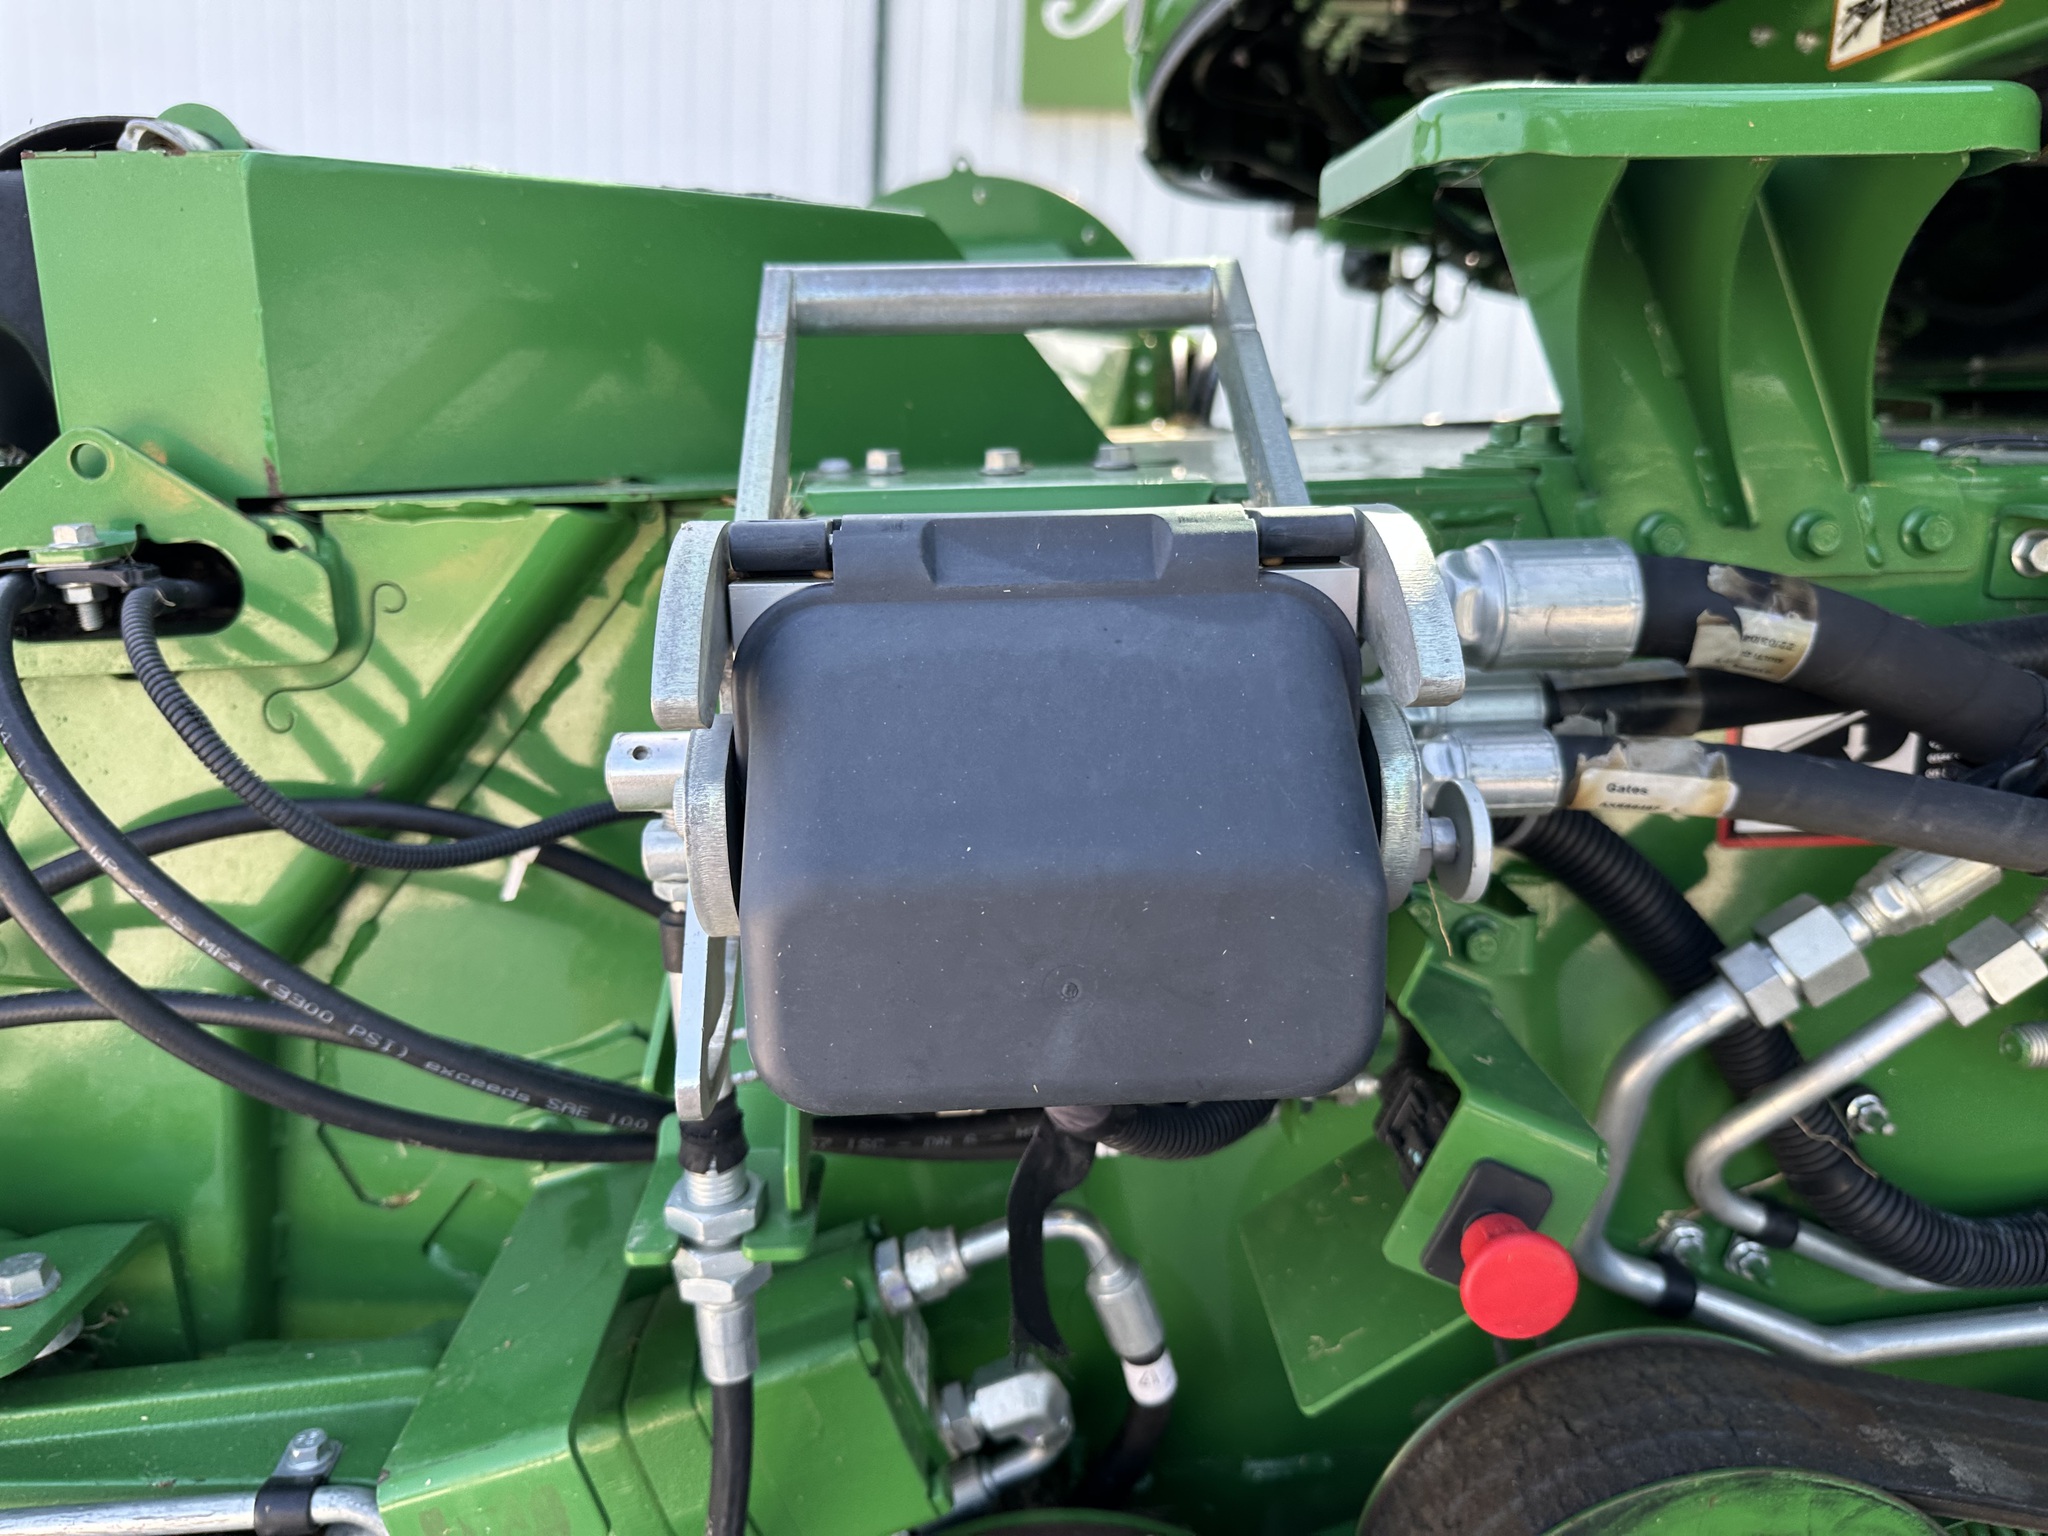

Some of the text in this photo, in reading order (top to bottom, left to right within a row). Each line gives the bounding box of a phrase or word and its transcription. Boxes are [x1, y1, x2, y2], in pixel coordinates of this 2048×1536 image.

[1605, 782, 1649, 796] Gates
[198, 936, 244, 974] MPa
[262, 978, 336, 1025] (3300
[347, 1023, 409, 1059] PSI)
[424, 1059, 531, 1104] exceeds
[545, 1096, 593, 1119] SAE
